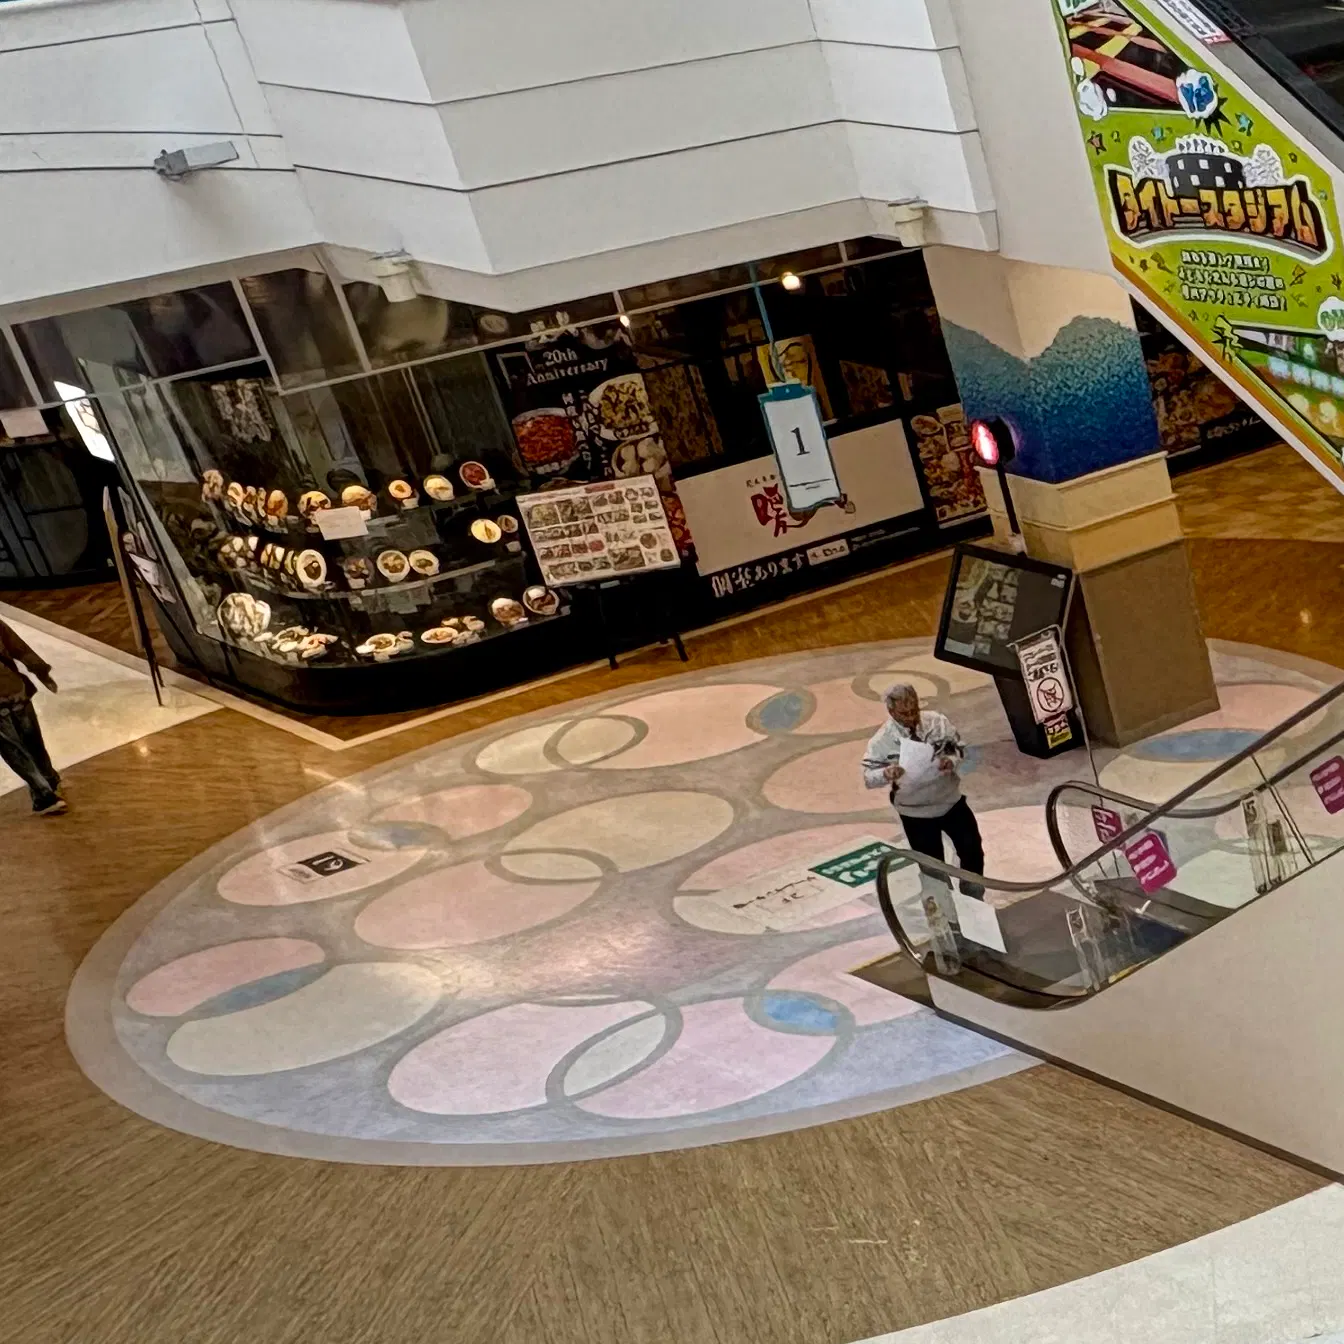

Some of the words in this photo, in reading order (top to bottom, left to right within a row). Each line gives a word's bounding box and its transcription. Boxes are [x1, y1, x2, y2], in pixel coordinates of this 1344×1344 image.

[1109, 170, 1328, 252] タイトースタジアム
[542, 348, 578, 367] 20th
[526, 358, 608, 387] Anniversary
[791, 428, 810, 456] 1
